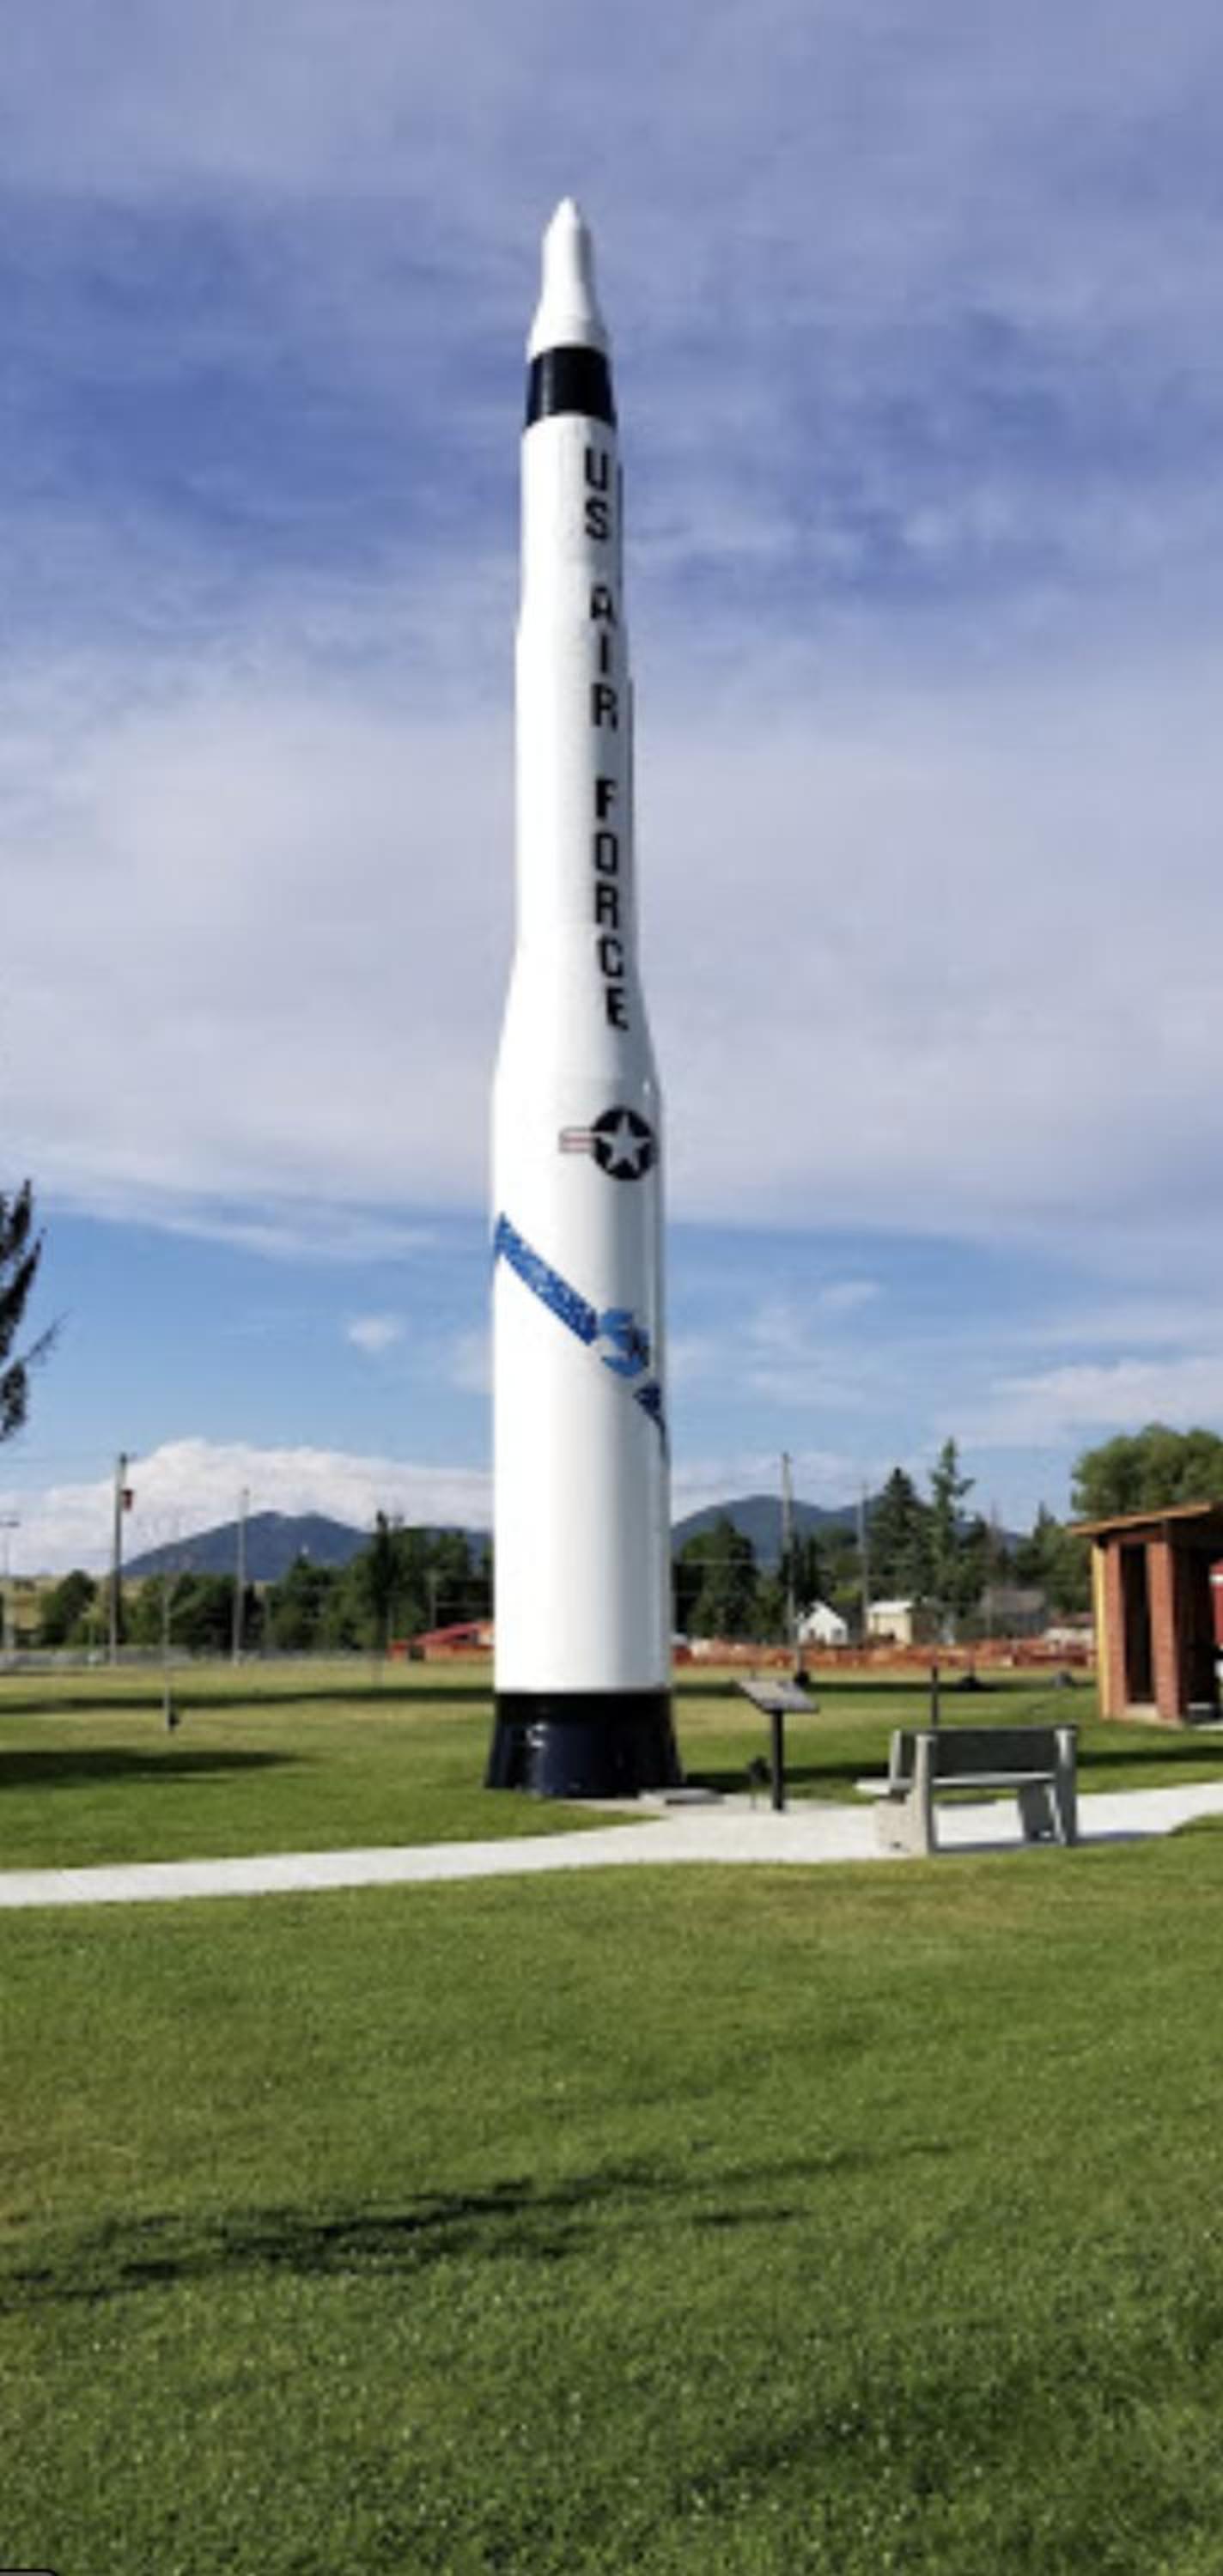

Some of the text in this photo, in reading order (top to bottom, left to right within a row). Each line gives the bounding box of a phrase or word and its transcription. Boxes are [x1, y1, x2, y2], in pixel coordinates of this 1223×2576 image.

[583, 447, 629, 1030] US AIR FORCE
